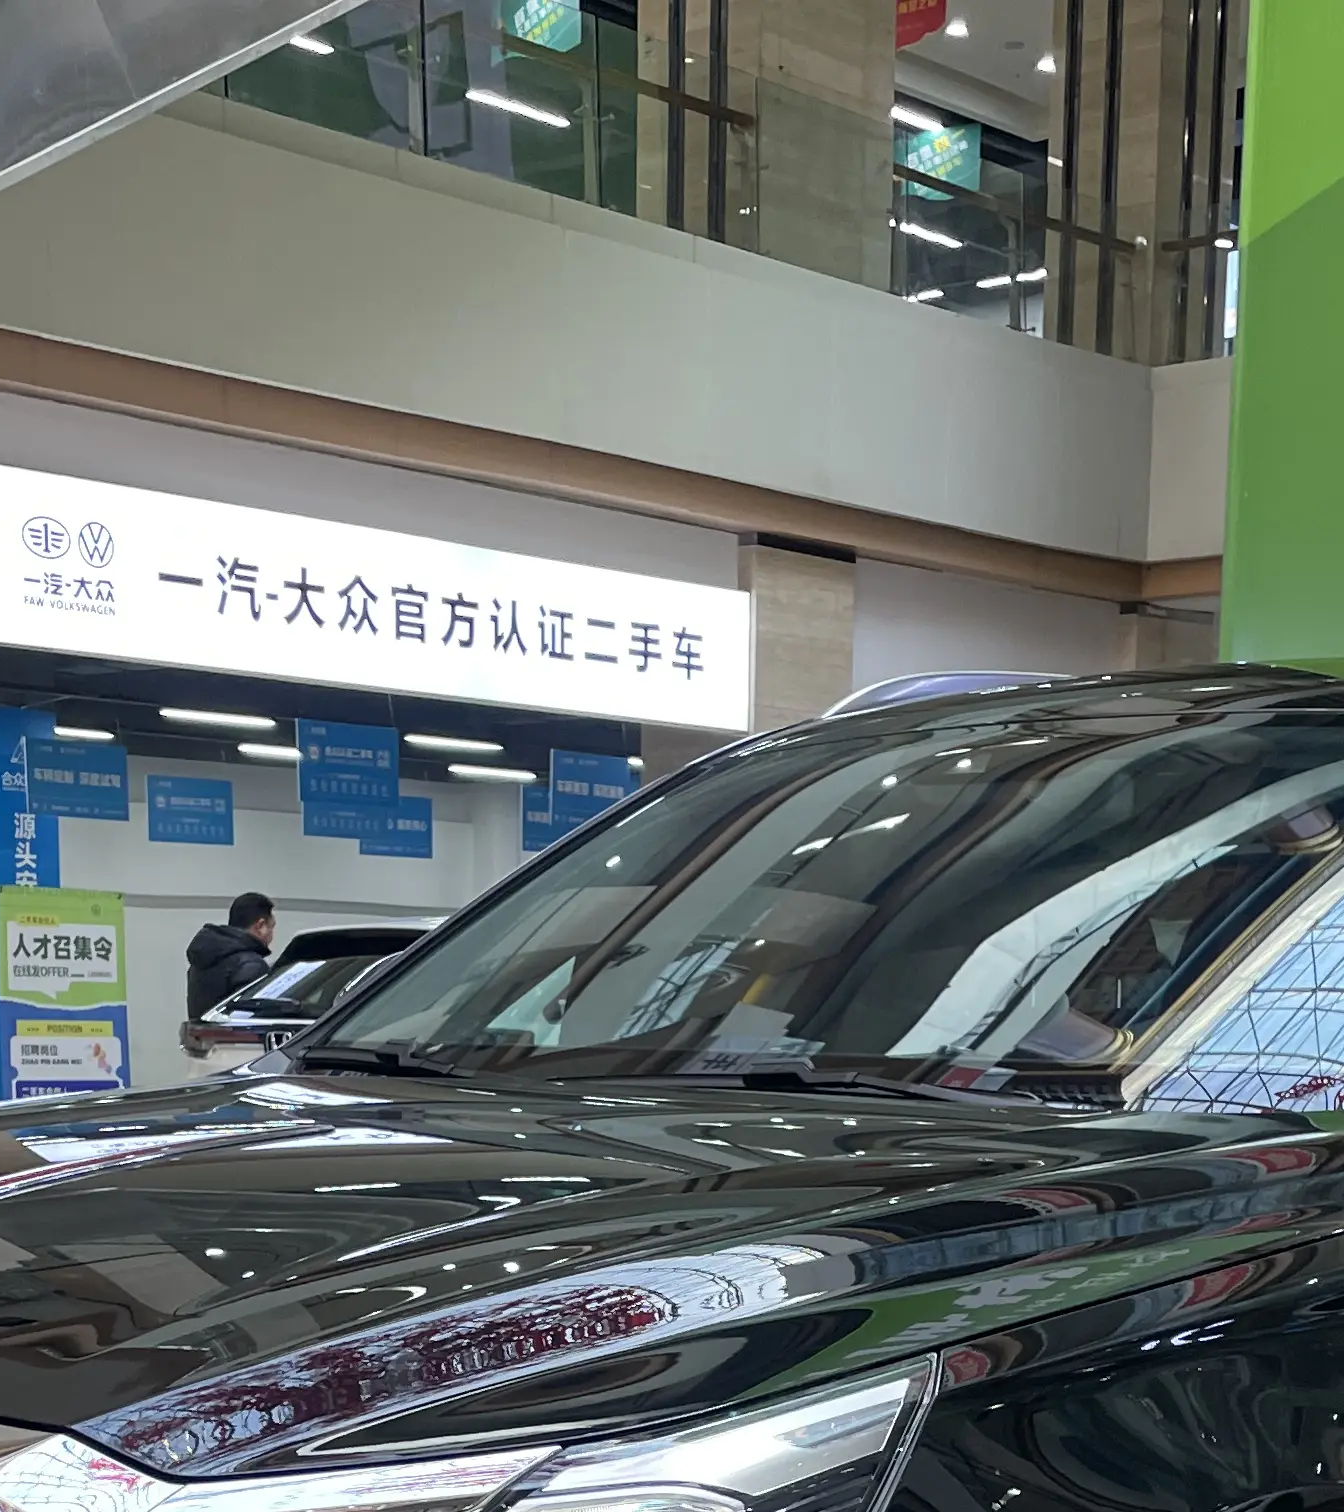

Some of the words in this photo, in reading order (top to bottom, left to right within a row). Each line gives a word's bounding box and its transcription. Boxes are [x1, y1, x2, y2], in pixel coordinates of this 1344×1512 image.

[24, 595, 45, 608] FAW
[49, 599, 117, 616] VOLKSWAGEN
[13, 932, 113, 962] 人才召集令
[46, 1024, 83, 1033] POSITION
